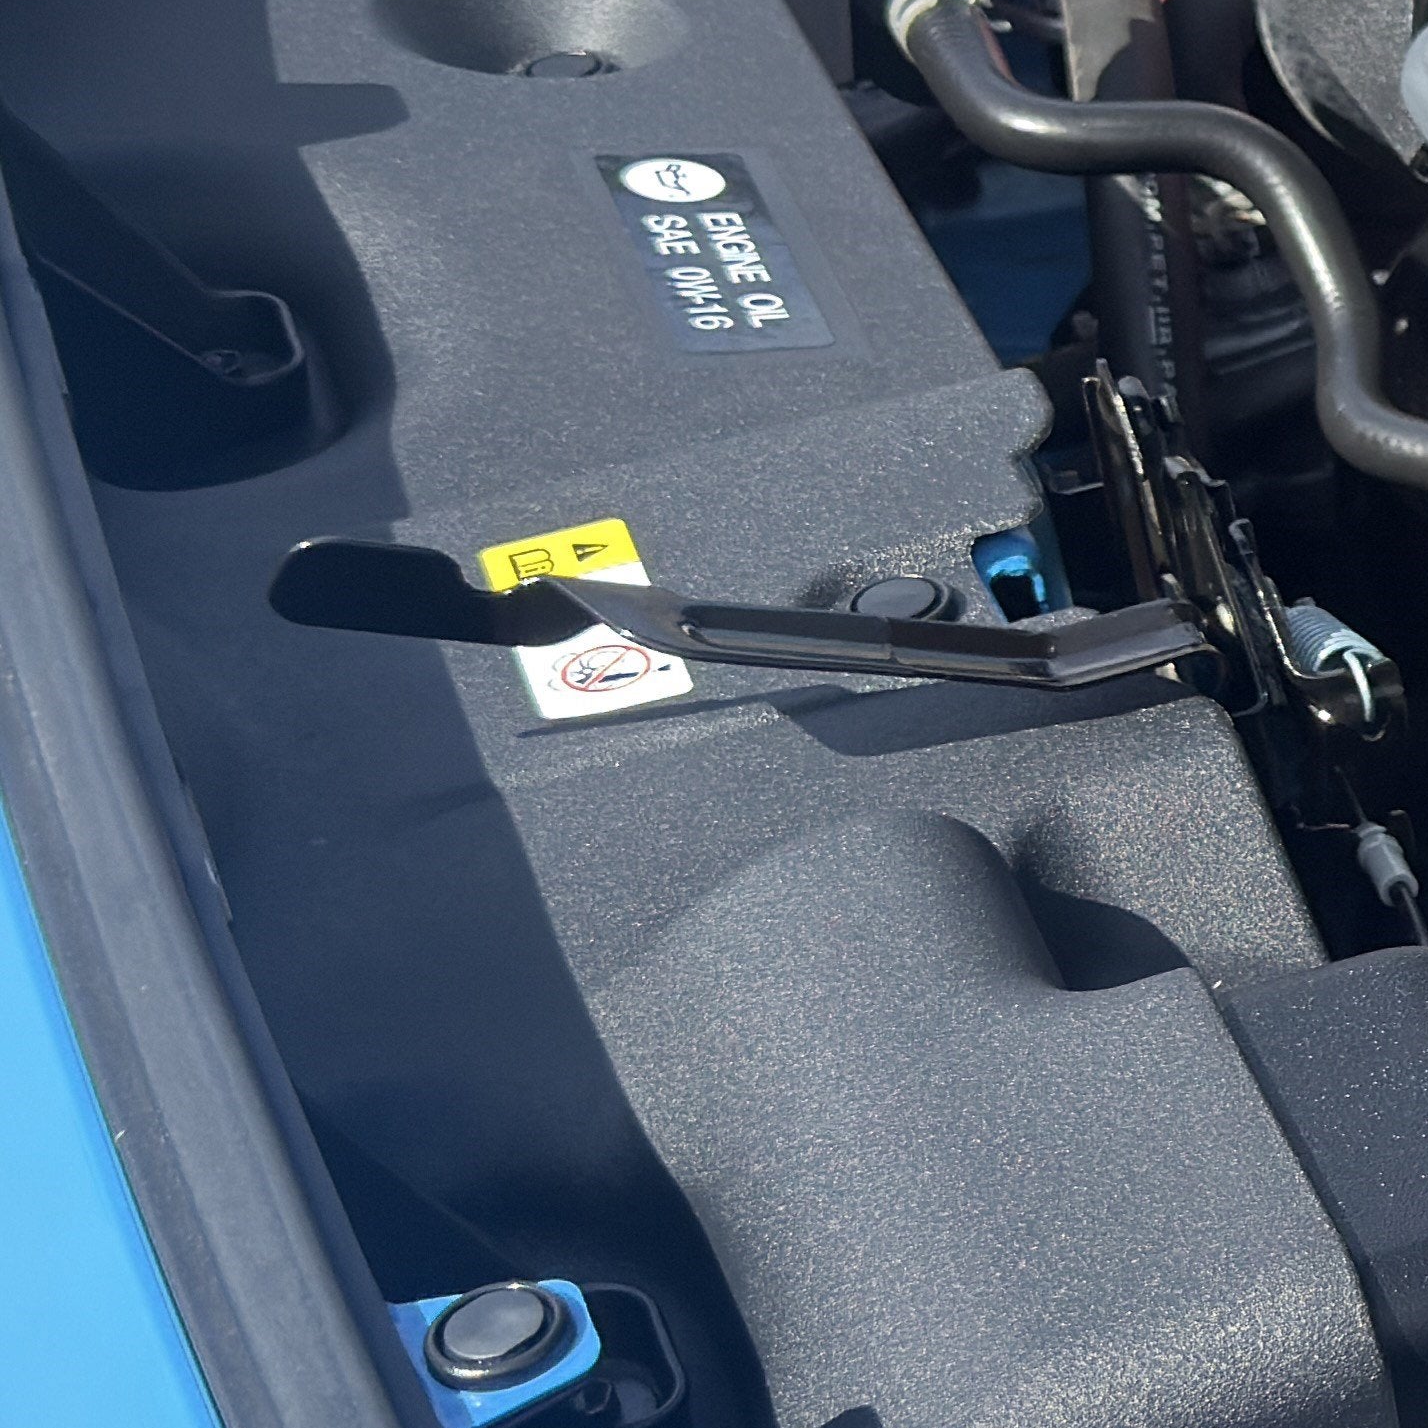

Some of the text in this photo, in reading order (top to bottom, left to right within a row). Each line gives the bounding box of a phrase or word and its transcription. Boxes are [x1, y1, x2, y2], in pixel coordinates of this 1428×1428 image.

[641, 214, 734, 330] SAE 0W-16
[697, 212, 790, 329] ENGINE OIL
